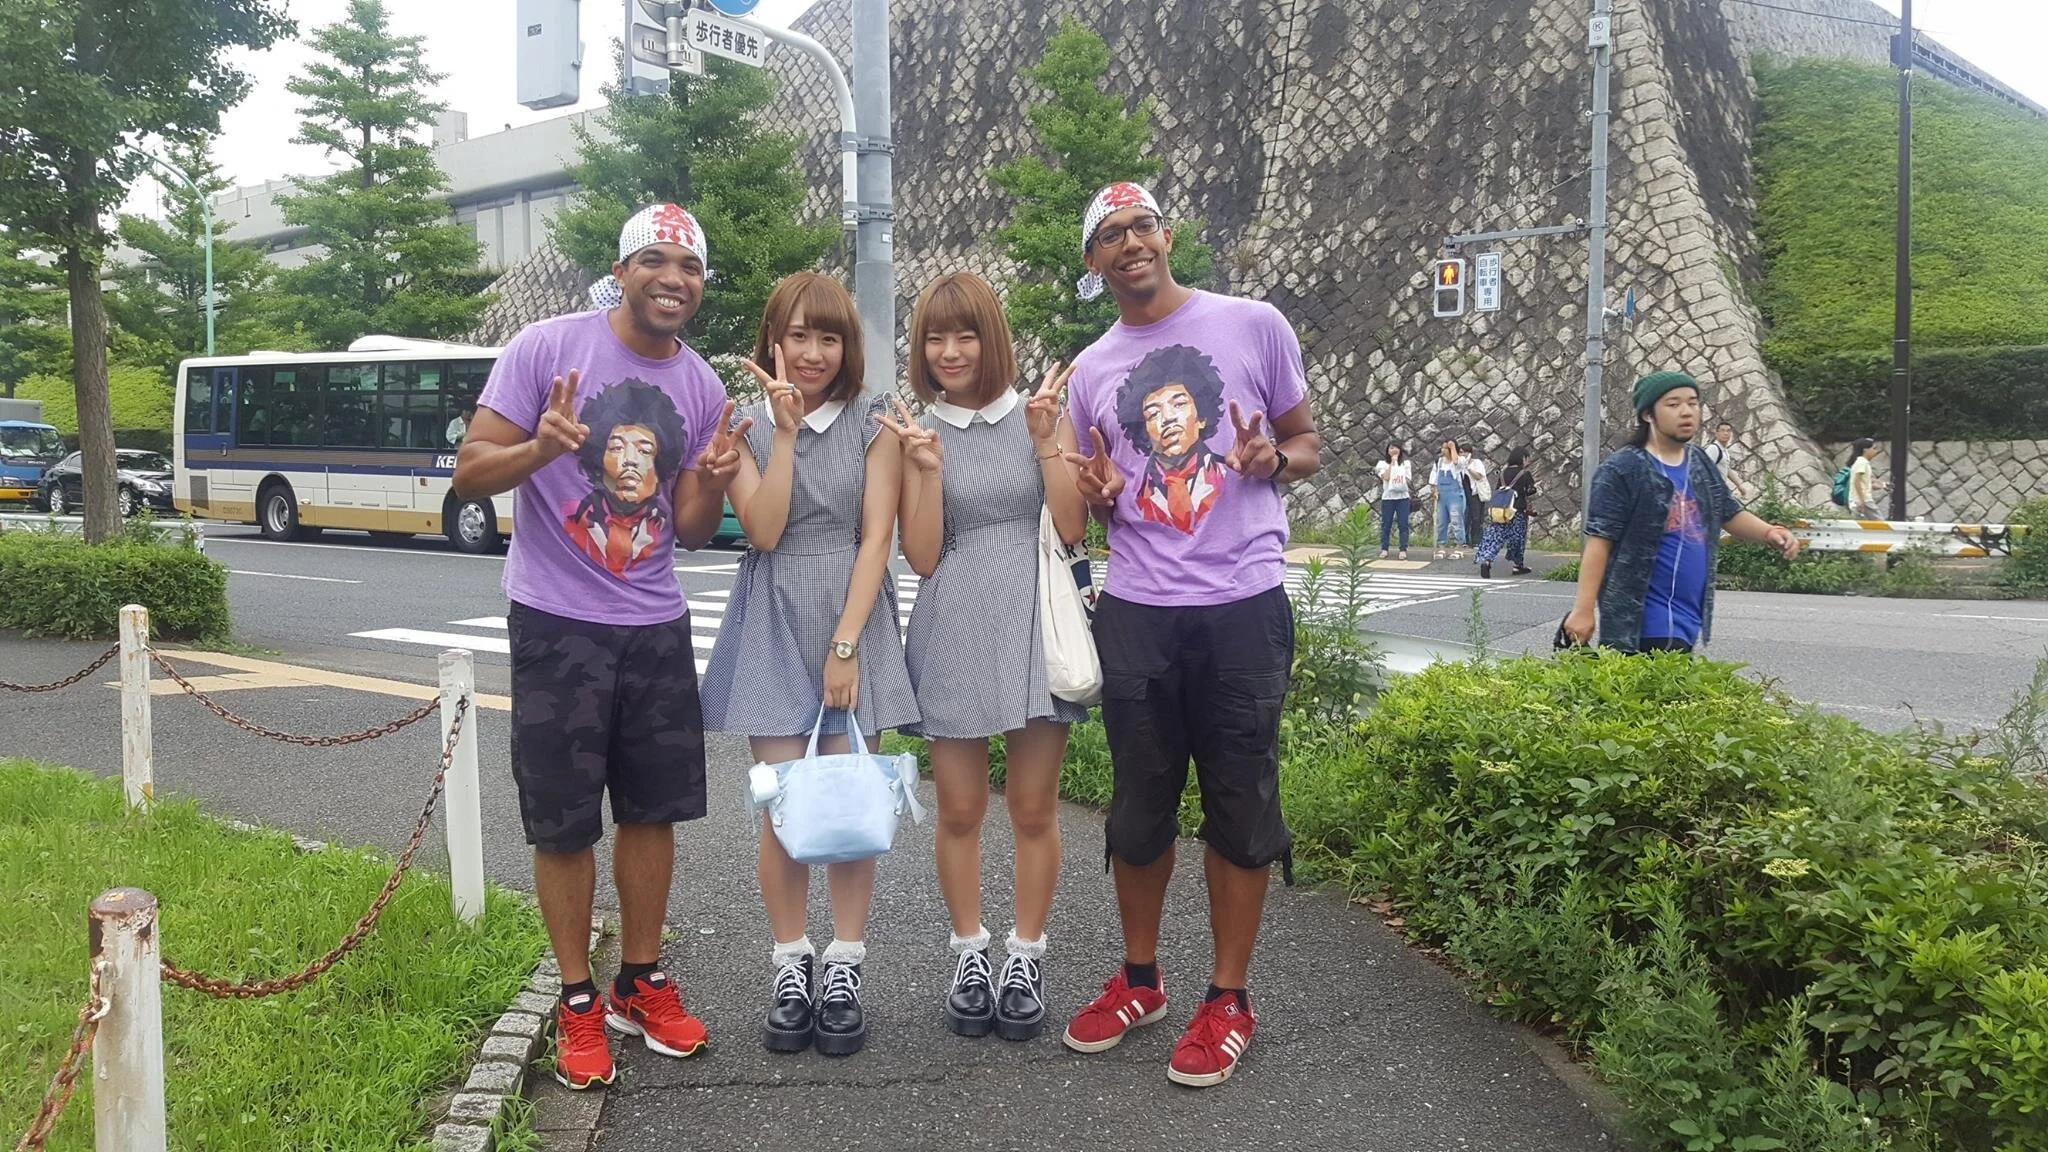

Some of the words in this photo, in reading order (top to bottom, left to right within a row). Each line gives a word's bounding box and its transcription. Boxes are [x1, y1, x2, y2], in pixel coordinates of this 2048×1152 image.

[696, 20, 758, 59] 歩行者優先
